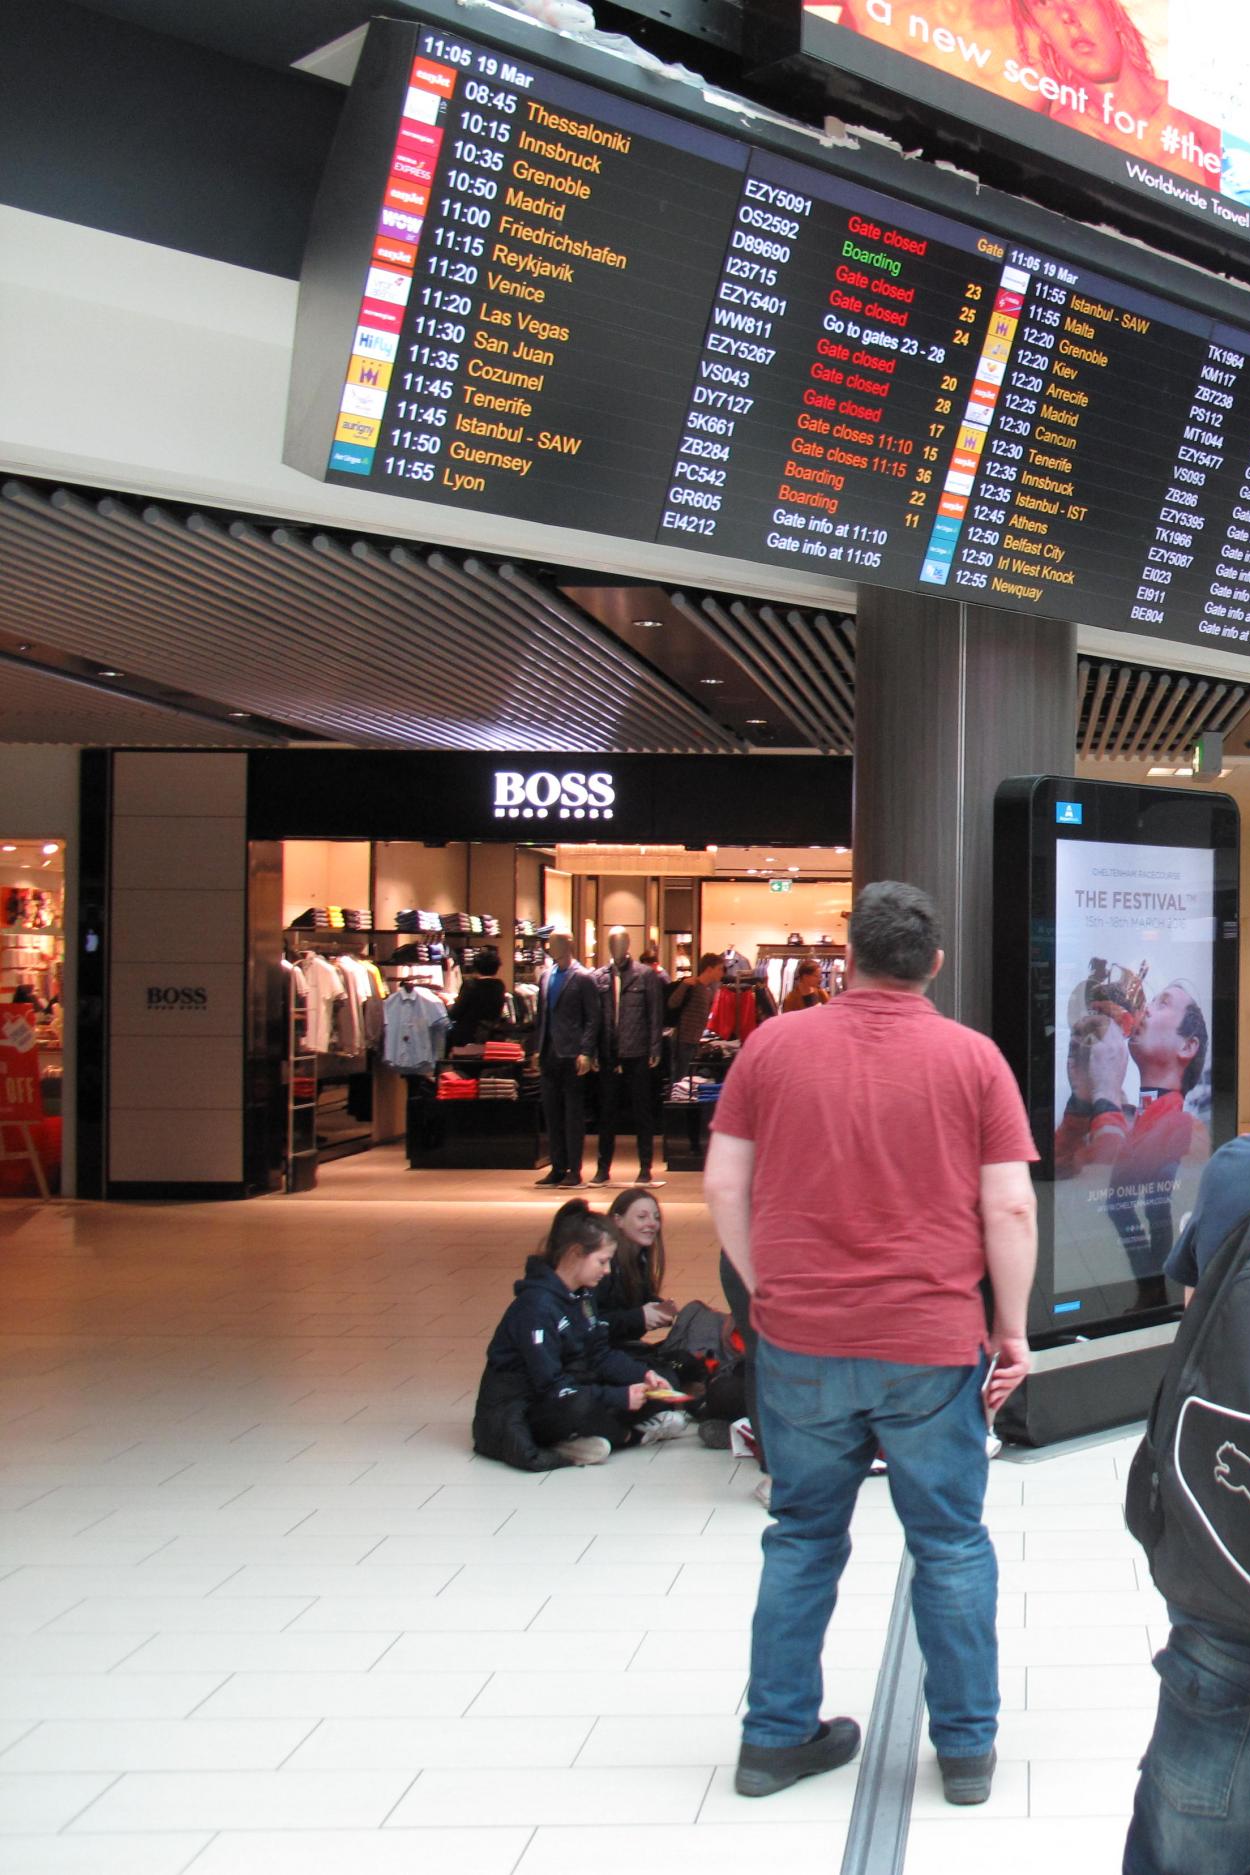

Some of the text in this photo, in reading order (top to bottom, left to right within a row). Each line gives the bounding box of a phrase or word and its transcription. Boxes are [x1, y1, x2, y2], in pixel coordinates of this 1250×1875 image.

[866, 0, 891, 25] a
[909, 15, 992, 68] new
[1003, 59, 1088, 113] scent
[1102, 92, 1148, 140] for
[393, 162, 432, 181] EXPRESS
[424, 36, 1003, 258] 11:05 19 Mar Gate
[464, 80, 518, 114] 08:45
[527, 101, 631, 153] Thessaloniki
[744, 178, 812, 216] EZY5091
[847, 215, 882, 240] Gate
[882, 230, 928, 256] closed
[1126, 161, 1207, 210] Worldwide
[1211, 198, 1250, 228] Travel
[454, 140, 976, 323] 10:35 Grenoble D89690 Gate closed 25
[461, 111, 511, 142] 10:15
[518, 130, 601, 174] Innsbruck
[738, 205, 799, 239] OS2592
[842, 240, 901, 277] Boarding
[965, 283, 982, 300] 23
[441, 198, 491, 228] 11:00
[499, 215, 626, 269] Friedrichshafen
[719, 281, 787, 316] EZY5401
[823, 313, 845, 333] Go
[846, 321, 861, 338] to
[861, 329, 899, 350] gates
[899, 337, 919, 355] 23
[927, 345, 945, 363] 28
[447, 169, 970, 346] 10:50 Madrid I23715 Gate closed 24
[1011, 250, 1041, 271] 11:05
[1043, 262, 1057, 277] 19
[1056, 266, 1079, 284] Mar
[428, 255, 951, 414] 11:20 Venice EZY5267 Gate closed 28
[434, 227, 957, 391] 11:15 Reykjavik WW811 Gate closed 20
[1023, 327, 1055, 349] 12:20
[1058, 339, 1108, 367] Grenoble
[1029, 304, 1061, 327] 11:55
[1064, 316, 1095, 339] Malta
[1200, 365, 1236, 387] KM117
[1035, 282, 1067, 305] 11:55
[1070, 295, 1114, 321] Istanbul
[1120, 313, 1150, 334] SAW
[422, 287, 945, 438] 11:20 Las Vegas VS043 Gate closed 17
[391, 428, 887, 545] 11:50 Guernsey GR605 Gate info at 11:10
[494, 772, 615, 806] BOSS
[1075, 890, 1107, 909] THE
[147, 987, 207, 1004] BOSS
[5, 1077, 34, 1104] OFF
[1087, 1179, 1182, 1202] JUMP ONLINE NOW
